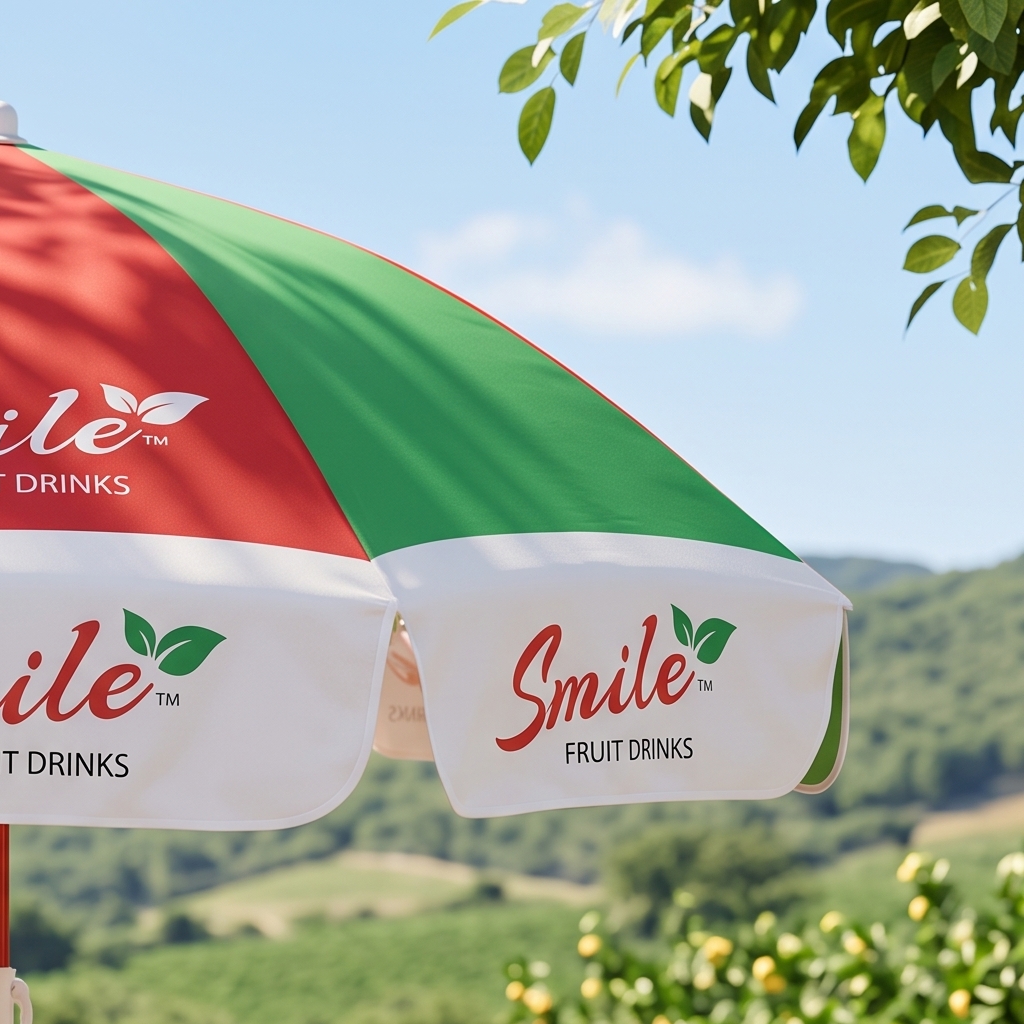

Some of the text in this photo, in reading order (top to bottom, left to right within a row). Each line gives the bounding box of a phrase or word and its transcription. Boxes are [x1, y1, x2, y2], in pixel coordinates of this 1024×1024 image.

[16, 473, 131, 495] DRINKS
[495, 614, 695, 752] Smile
[565, 737, 693, 764] FRUIT DRINKS
[28, 751, 129, 777] DRINKS
